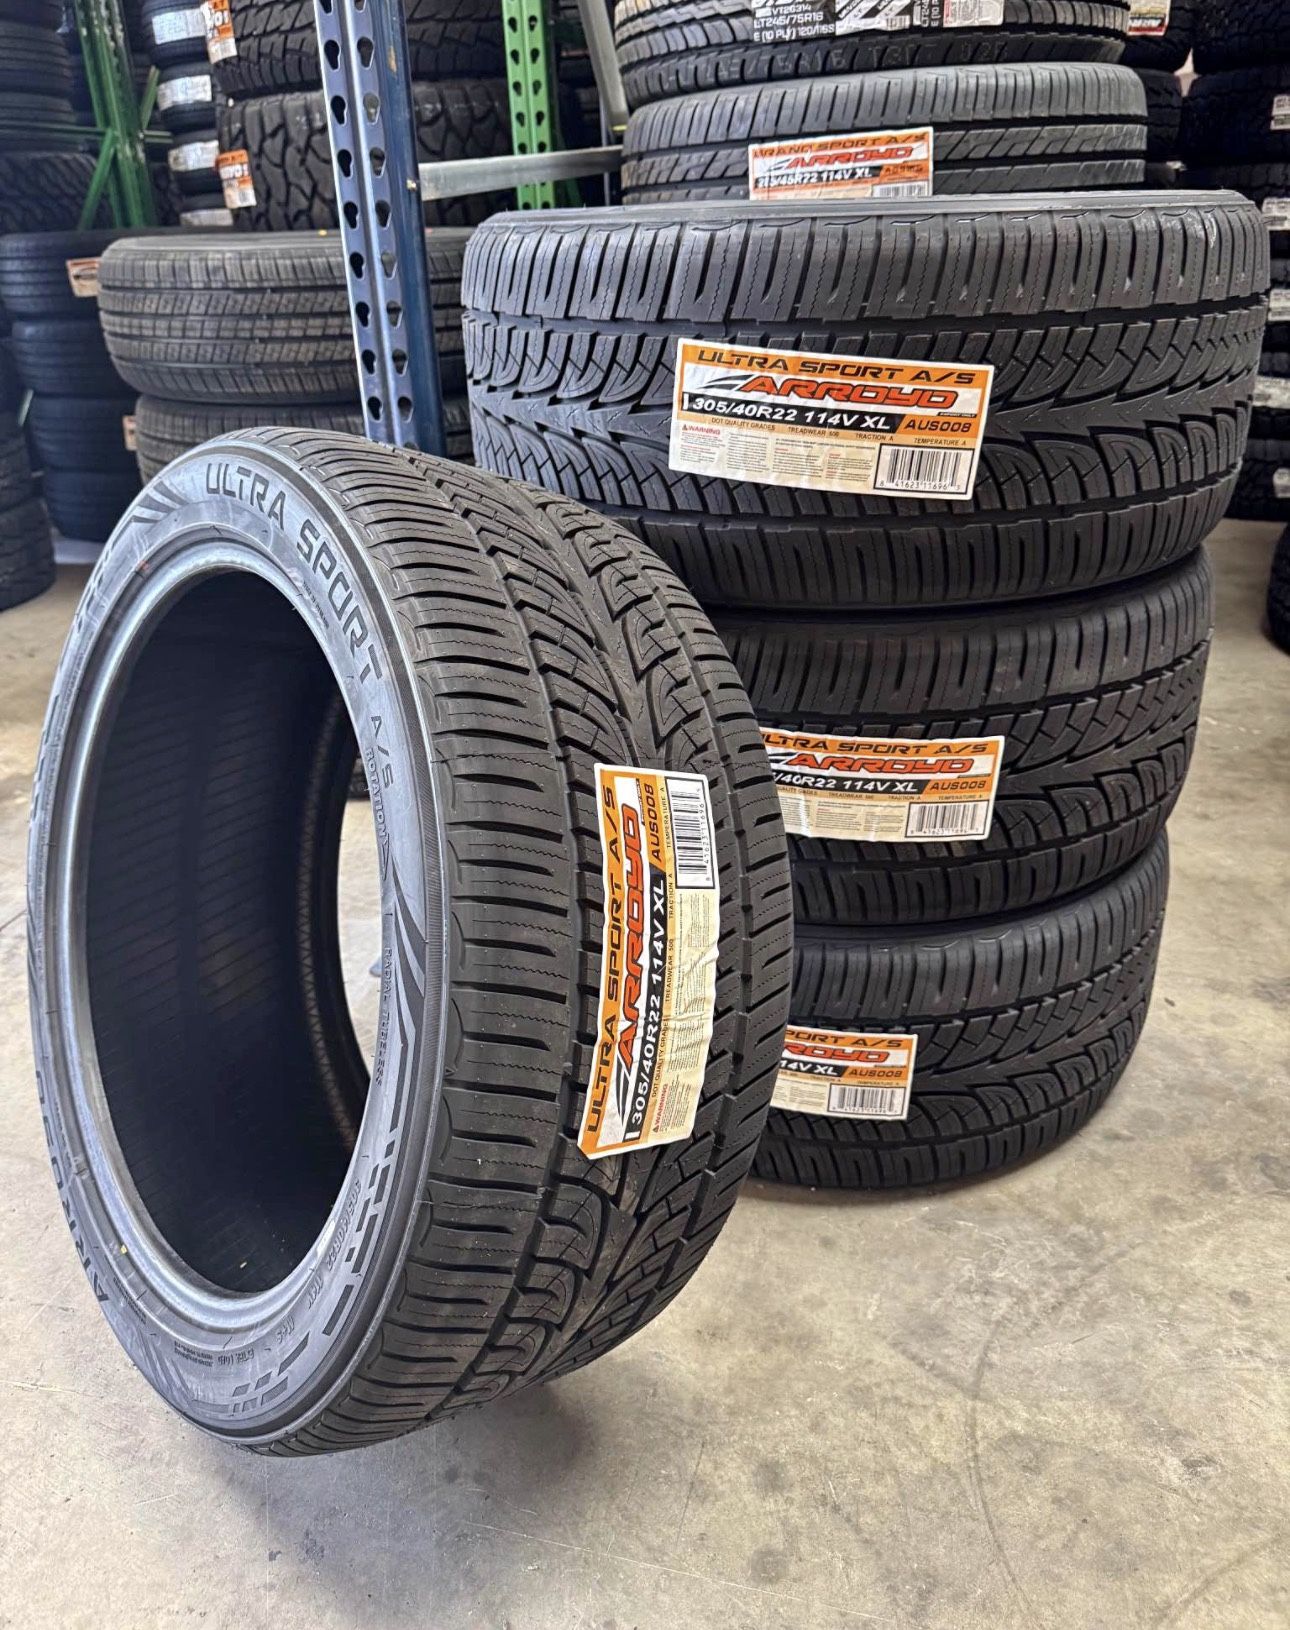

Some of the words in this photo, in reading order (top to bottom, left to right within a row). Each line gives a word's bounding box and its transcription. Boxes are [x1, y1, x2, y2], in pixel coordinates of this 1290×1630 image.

[753, 11, 824, 29] LT245/75R16
[754, 32, 760, 42] E
[785, 147, 914, 169] ARROYO
[817, 137, 882, 150] SPORT
[886, 134, 926, 144] A/S
[820, 168, 854, 182] 114V
[854, 168, 872, 179] XL
[697, 349, 789, 370] ULTRA
[799, 360, 905, 380] SPORT
[910, 369, 977, 385] A/S
[739, 374, 959, 409] ARROYO
[688, 425, 721, 436] WARNING
[692, 397, 797, 422] 305/40R22
[804, 410, 859, 428] 114V
[860, 415, 891, 430] XL
[904, 418, 972, 434] AUS008
[711, 417, 724, 425] DOT
[724, 419, 750, 428] QUALITY
[750, 422, 776, 431] GRADES
[788, 426, 827, 437] TREADWEAR
[856, 433, 887, 442] TRACTION
[913, 437, 956, 447] TEMPERATURE
[205, 462, 286, 531] ULTRA
[296, 518, 383, 685] SPORT
[370, 715, 394, 790] A/S
[786, 753, 975, 775] ARROYO
[836, 742, 928, 755] SPORT
[933, 743, 988, 755] A/S
[364, 747, 388, 838] ROTATION
[842, 780, 891, 792] 114V
[891, 781, 918, 793] XL
[929, 780, 987, 791] AUS008
[602, 785, 622, 865] A/S
[643, 783, 662, 863] AUS008
[661, 795, 671, 848] TEMPERATURE
[652, 879, 666, 916] XL
[607, 872, 623, 1002] SPORT
[617, 803, 645, 1073] ARROYO
[650, 914, 667, 986] 114V
[383, 947, 393, 1001] RADIAL
[664, 955, 674, 1002] TREADWEAR
[631, 994, 662, 1126] 305/40R22
[850, 1037, 904, 1048] A/S
[587, 1014, 618, 1133] ULTRA
[654, 1050, 665, 1083] QUALITY
[813, 1065, 839, 1076] XL
[848, 1068, 904, 1078] AUS008
[654, 1083, 669, 1126] WARNING
